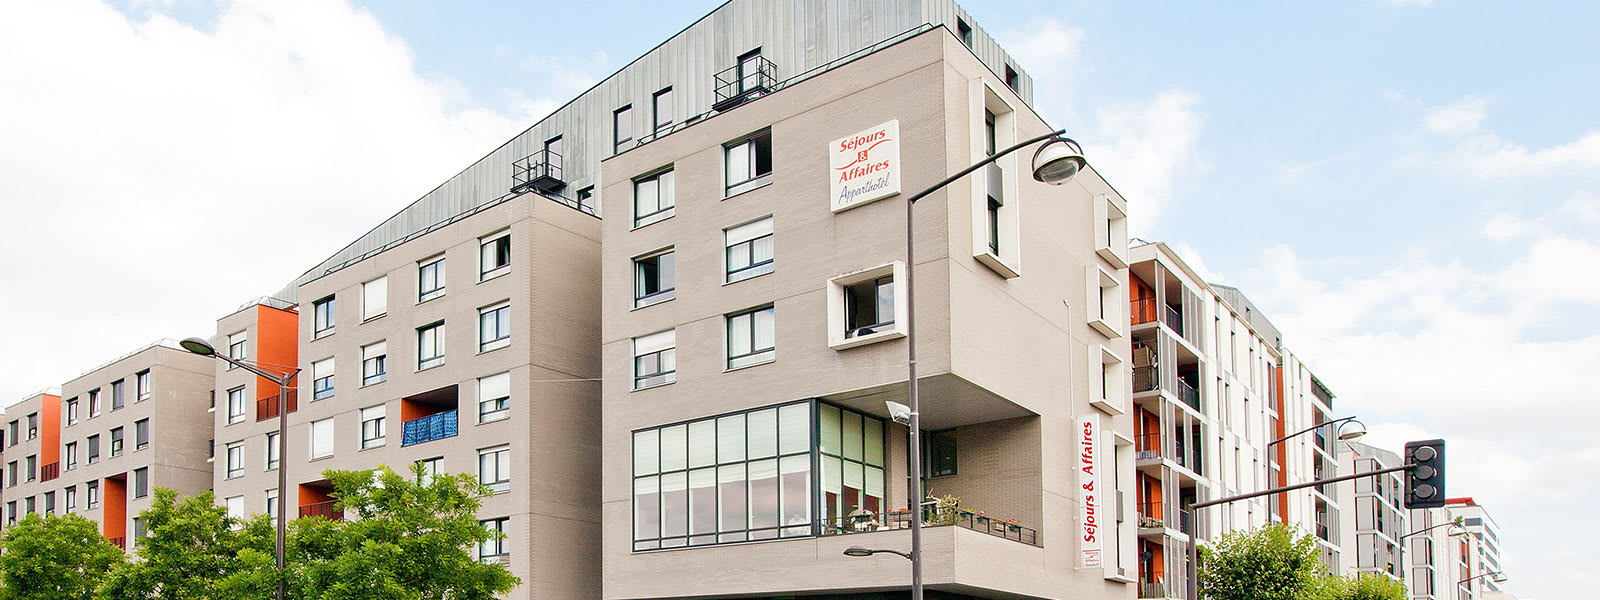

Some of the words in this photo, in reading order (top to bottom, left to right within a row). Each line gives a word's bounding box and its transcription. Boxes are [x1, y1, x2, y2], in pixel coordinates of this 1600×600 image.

[839, 129, 886, 153] Séjours
[859, 151, 868, 161] &
[838, 160, 889, 183] Affaires
[838, 172, 890, 204] Apparthotel
[1081, 421, 1094, 475] Affaires
[1082, 480, 1094, 492] &
[1083, 494, 1098, 543] Séjours
